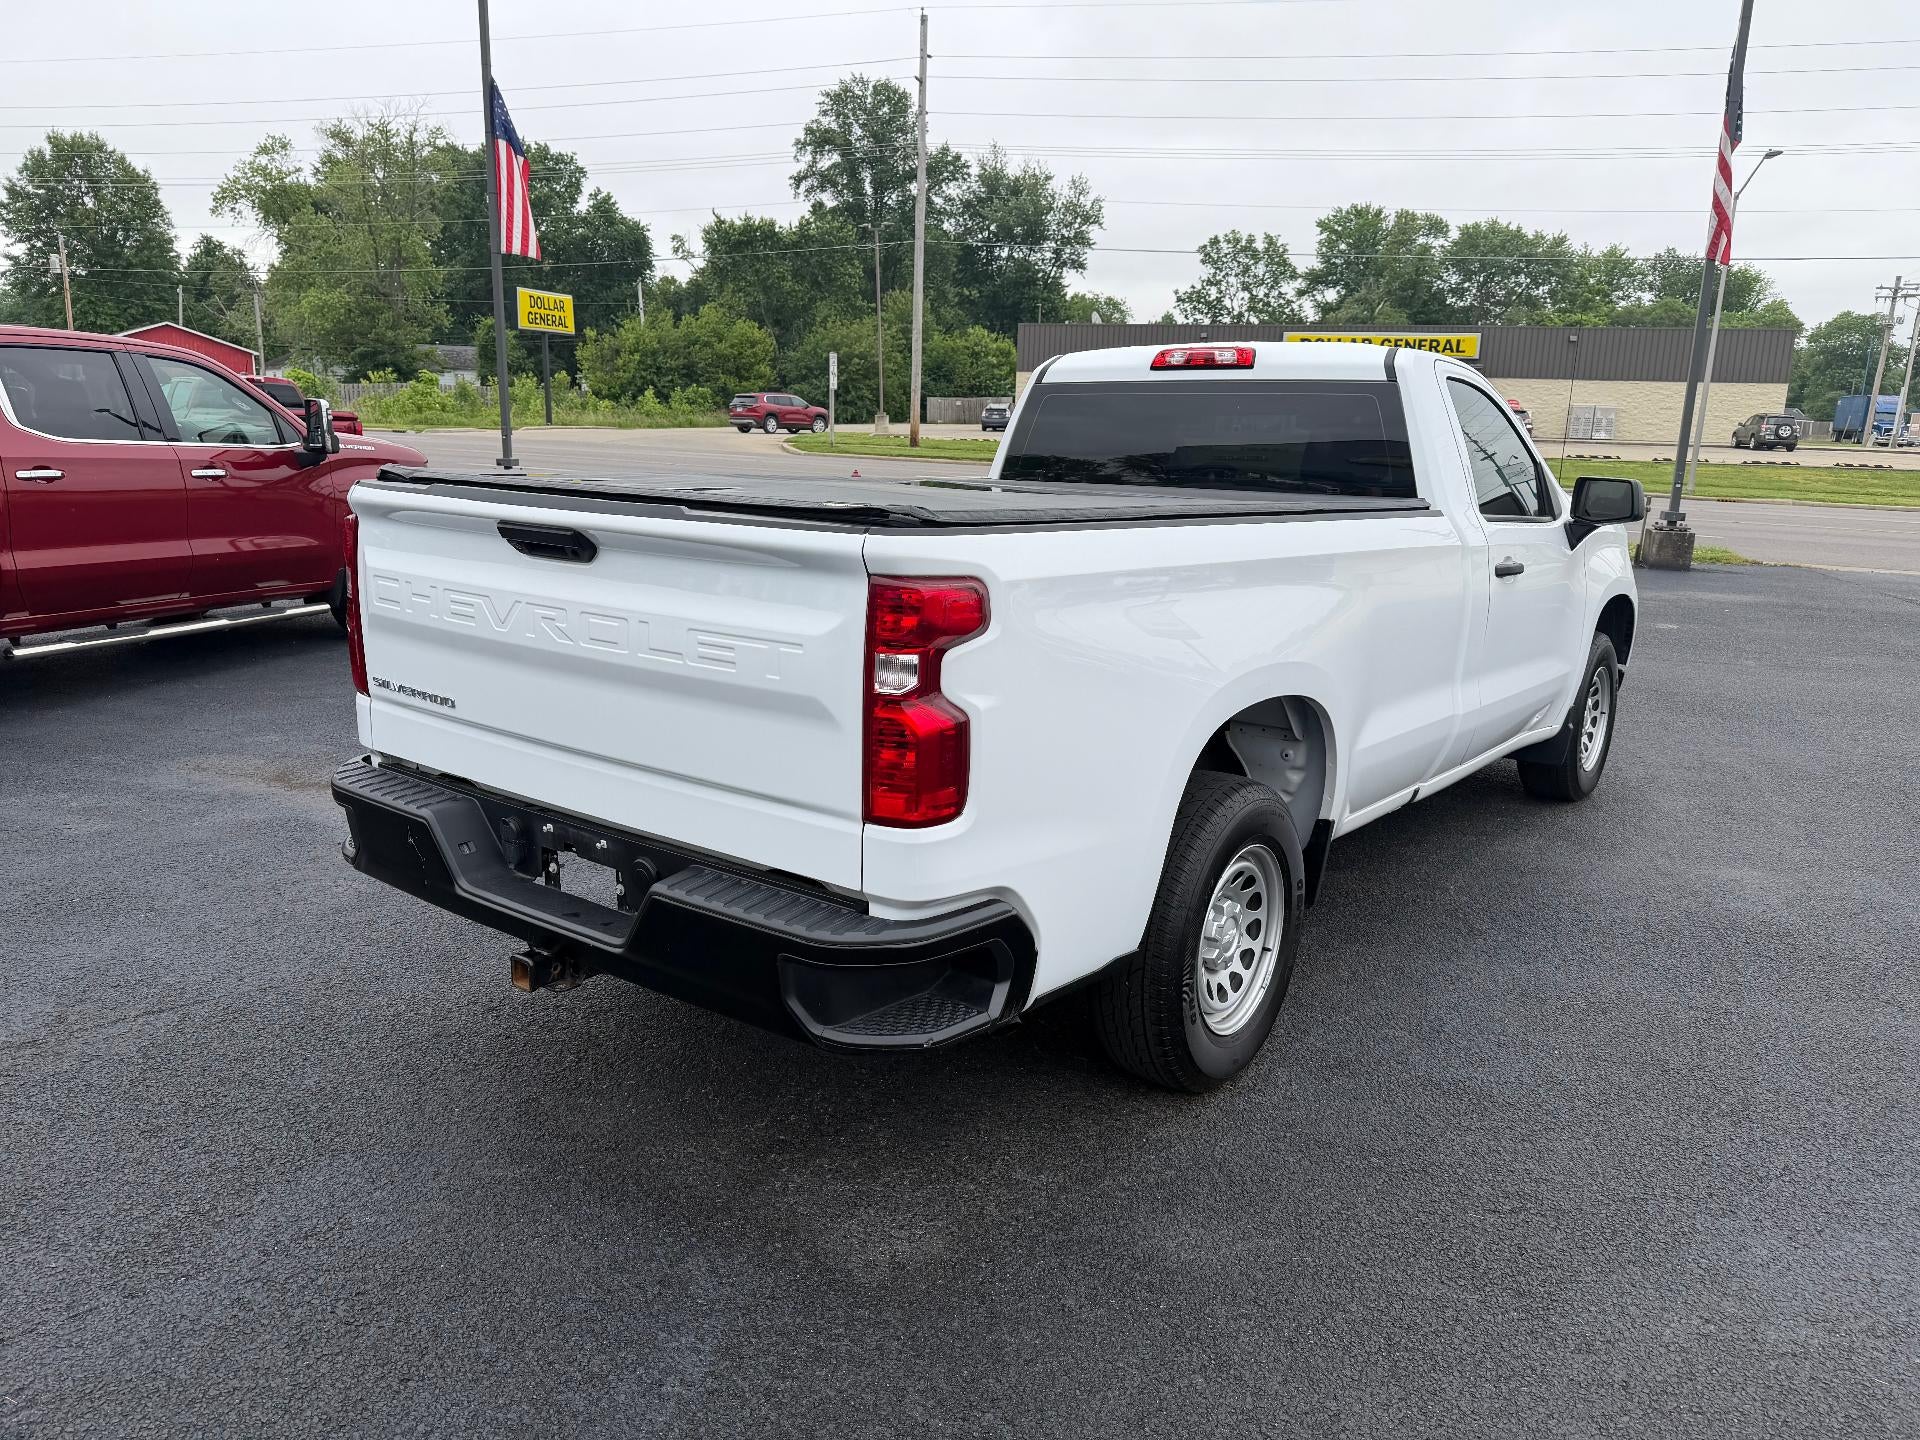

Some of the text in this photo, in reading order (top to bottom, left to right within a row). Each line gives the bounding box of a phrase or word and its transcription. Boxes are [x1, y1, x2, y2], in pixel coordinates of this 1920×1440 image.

[529, 295, 565, 312] DOLLAR
[527, 311, 569, 329] GENERAL
[372, 574, 805, 680] CHEVROLET
[372, 676, 456, 709] SILVERADO
